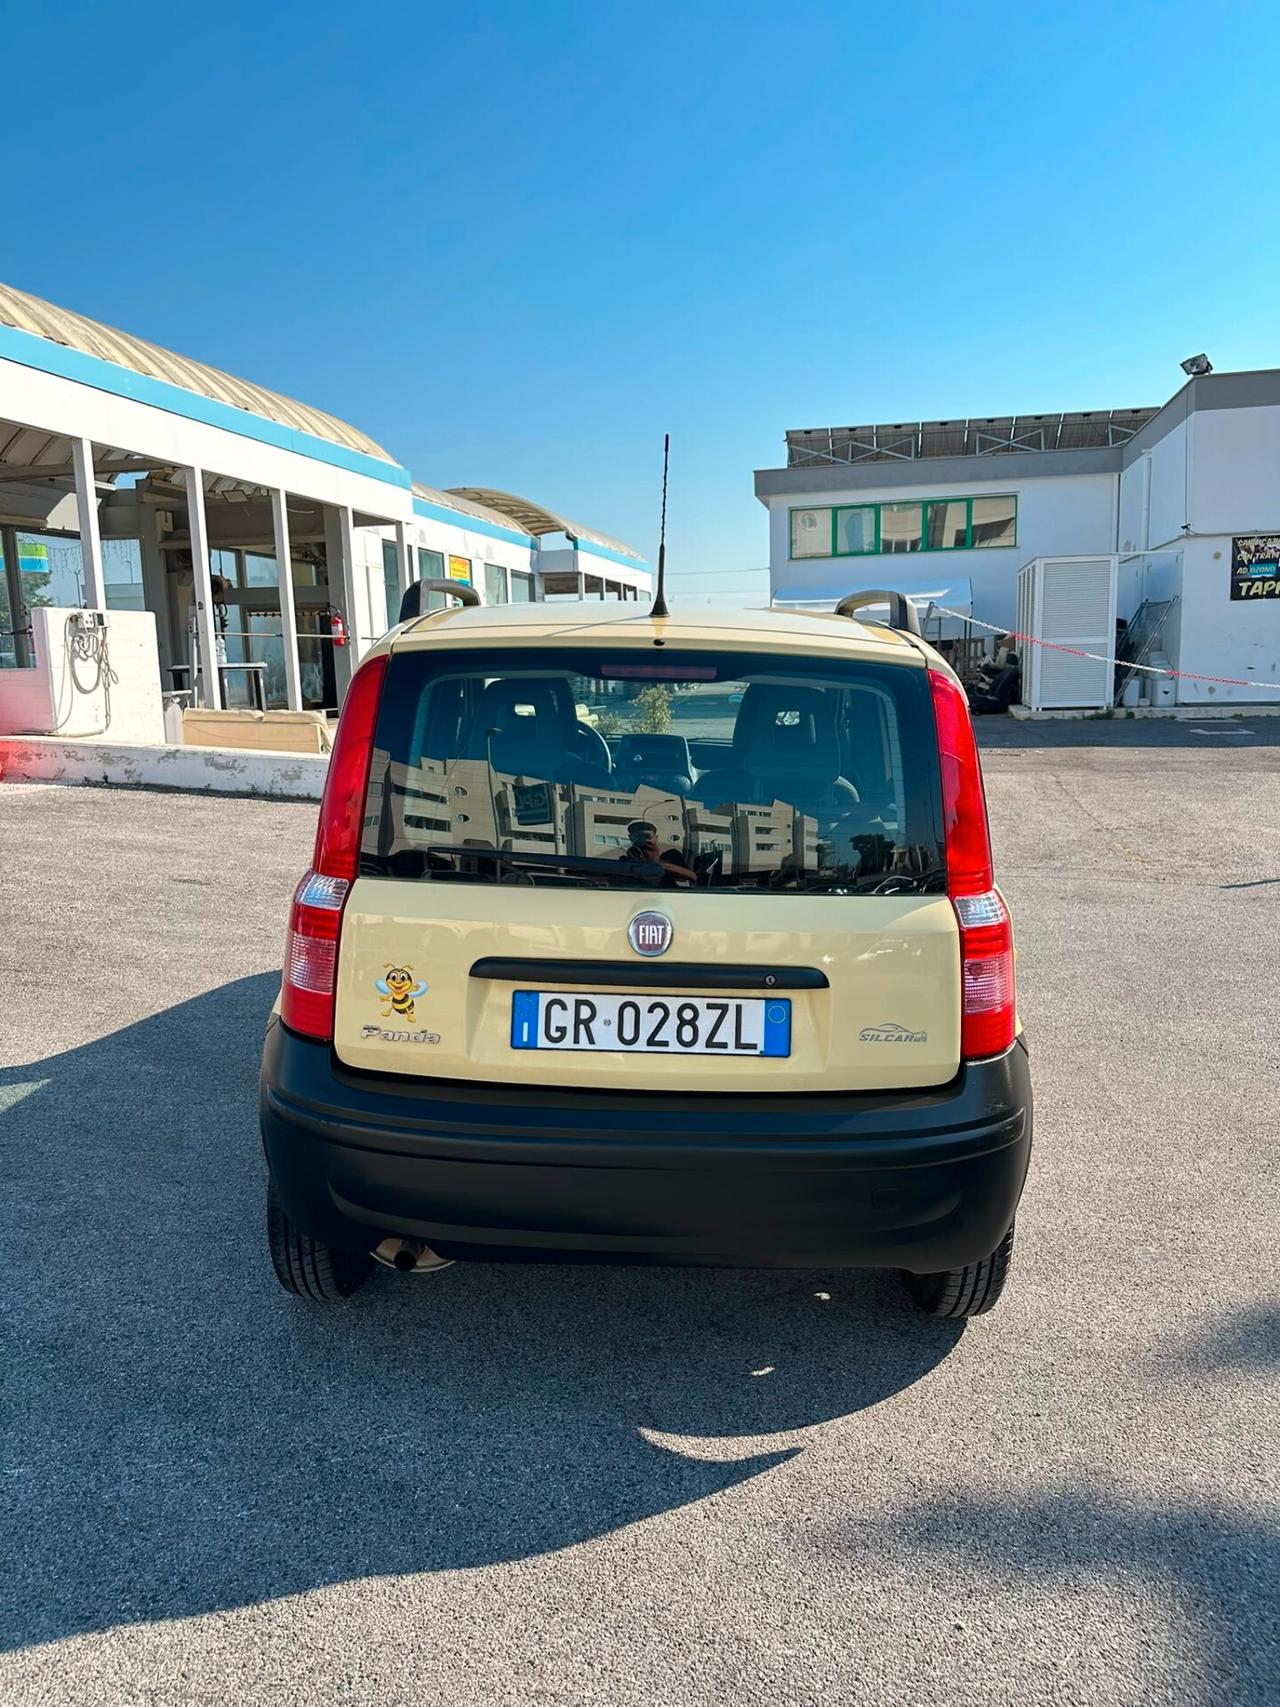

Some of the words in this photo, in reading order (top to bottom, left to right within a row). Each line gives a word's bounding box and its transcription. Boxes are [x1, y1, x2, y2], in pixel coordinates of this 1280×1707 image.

[1250, 566, 1276, 574] OZONO
[639, 925, 665, 944] FIAT
[544, 999, 597, 1045] GR
[617, 1001, 758, 1050] 028ZL
[361, 1025, 441, 1044] Panda
